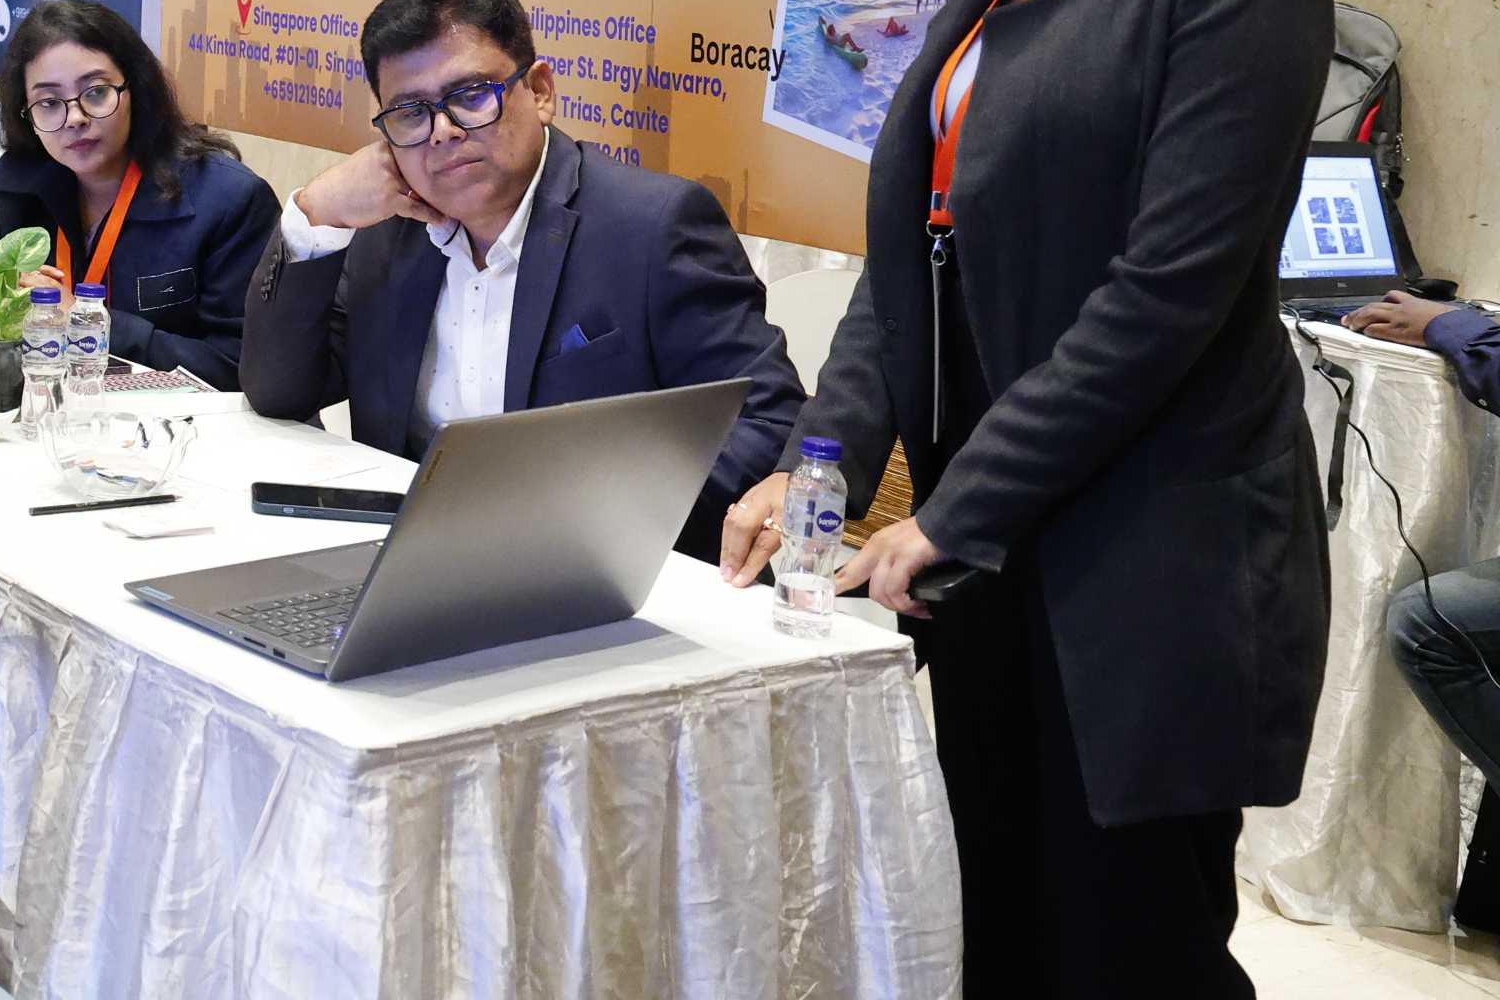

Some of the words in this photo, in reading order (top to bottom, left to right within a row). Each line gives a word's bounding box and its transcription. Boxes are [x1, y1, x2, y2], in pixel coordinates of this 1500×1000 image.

[253, 4, 317, 36] Singapore
[320, 14, 358, 38] Office
[605, 15, 656, 44] Office
[189, 33, 203, 50] 44
[205, 34, 236, 57] Kinta
[239, 40, 272, 64] Road,
[276, 45, 321, 72] #01-01,
[691, 32, 786, 82] Boracay
[263, 79, 342, 109] +6591219604
[577, 56, 597, 80] St.
[602, 59, 642, 93] Brgy
[646, 65, 727, 102] Navarro,
[561, 95, 606, 128] Trias,
[611, 103, 669, 134] Cavite
